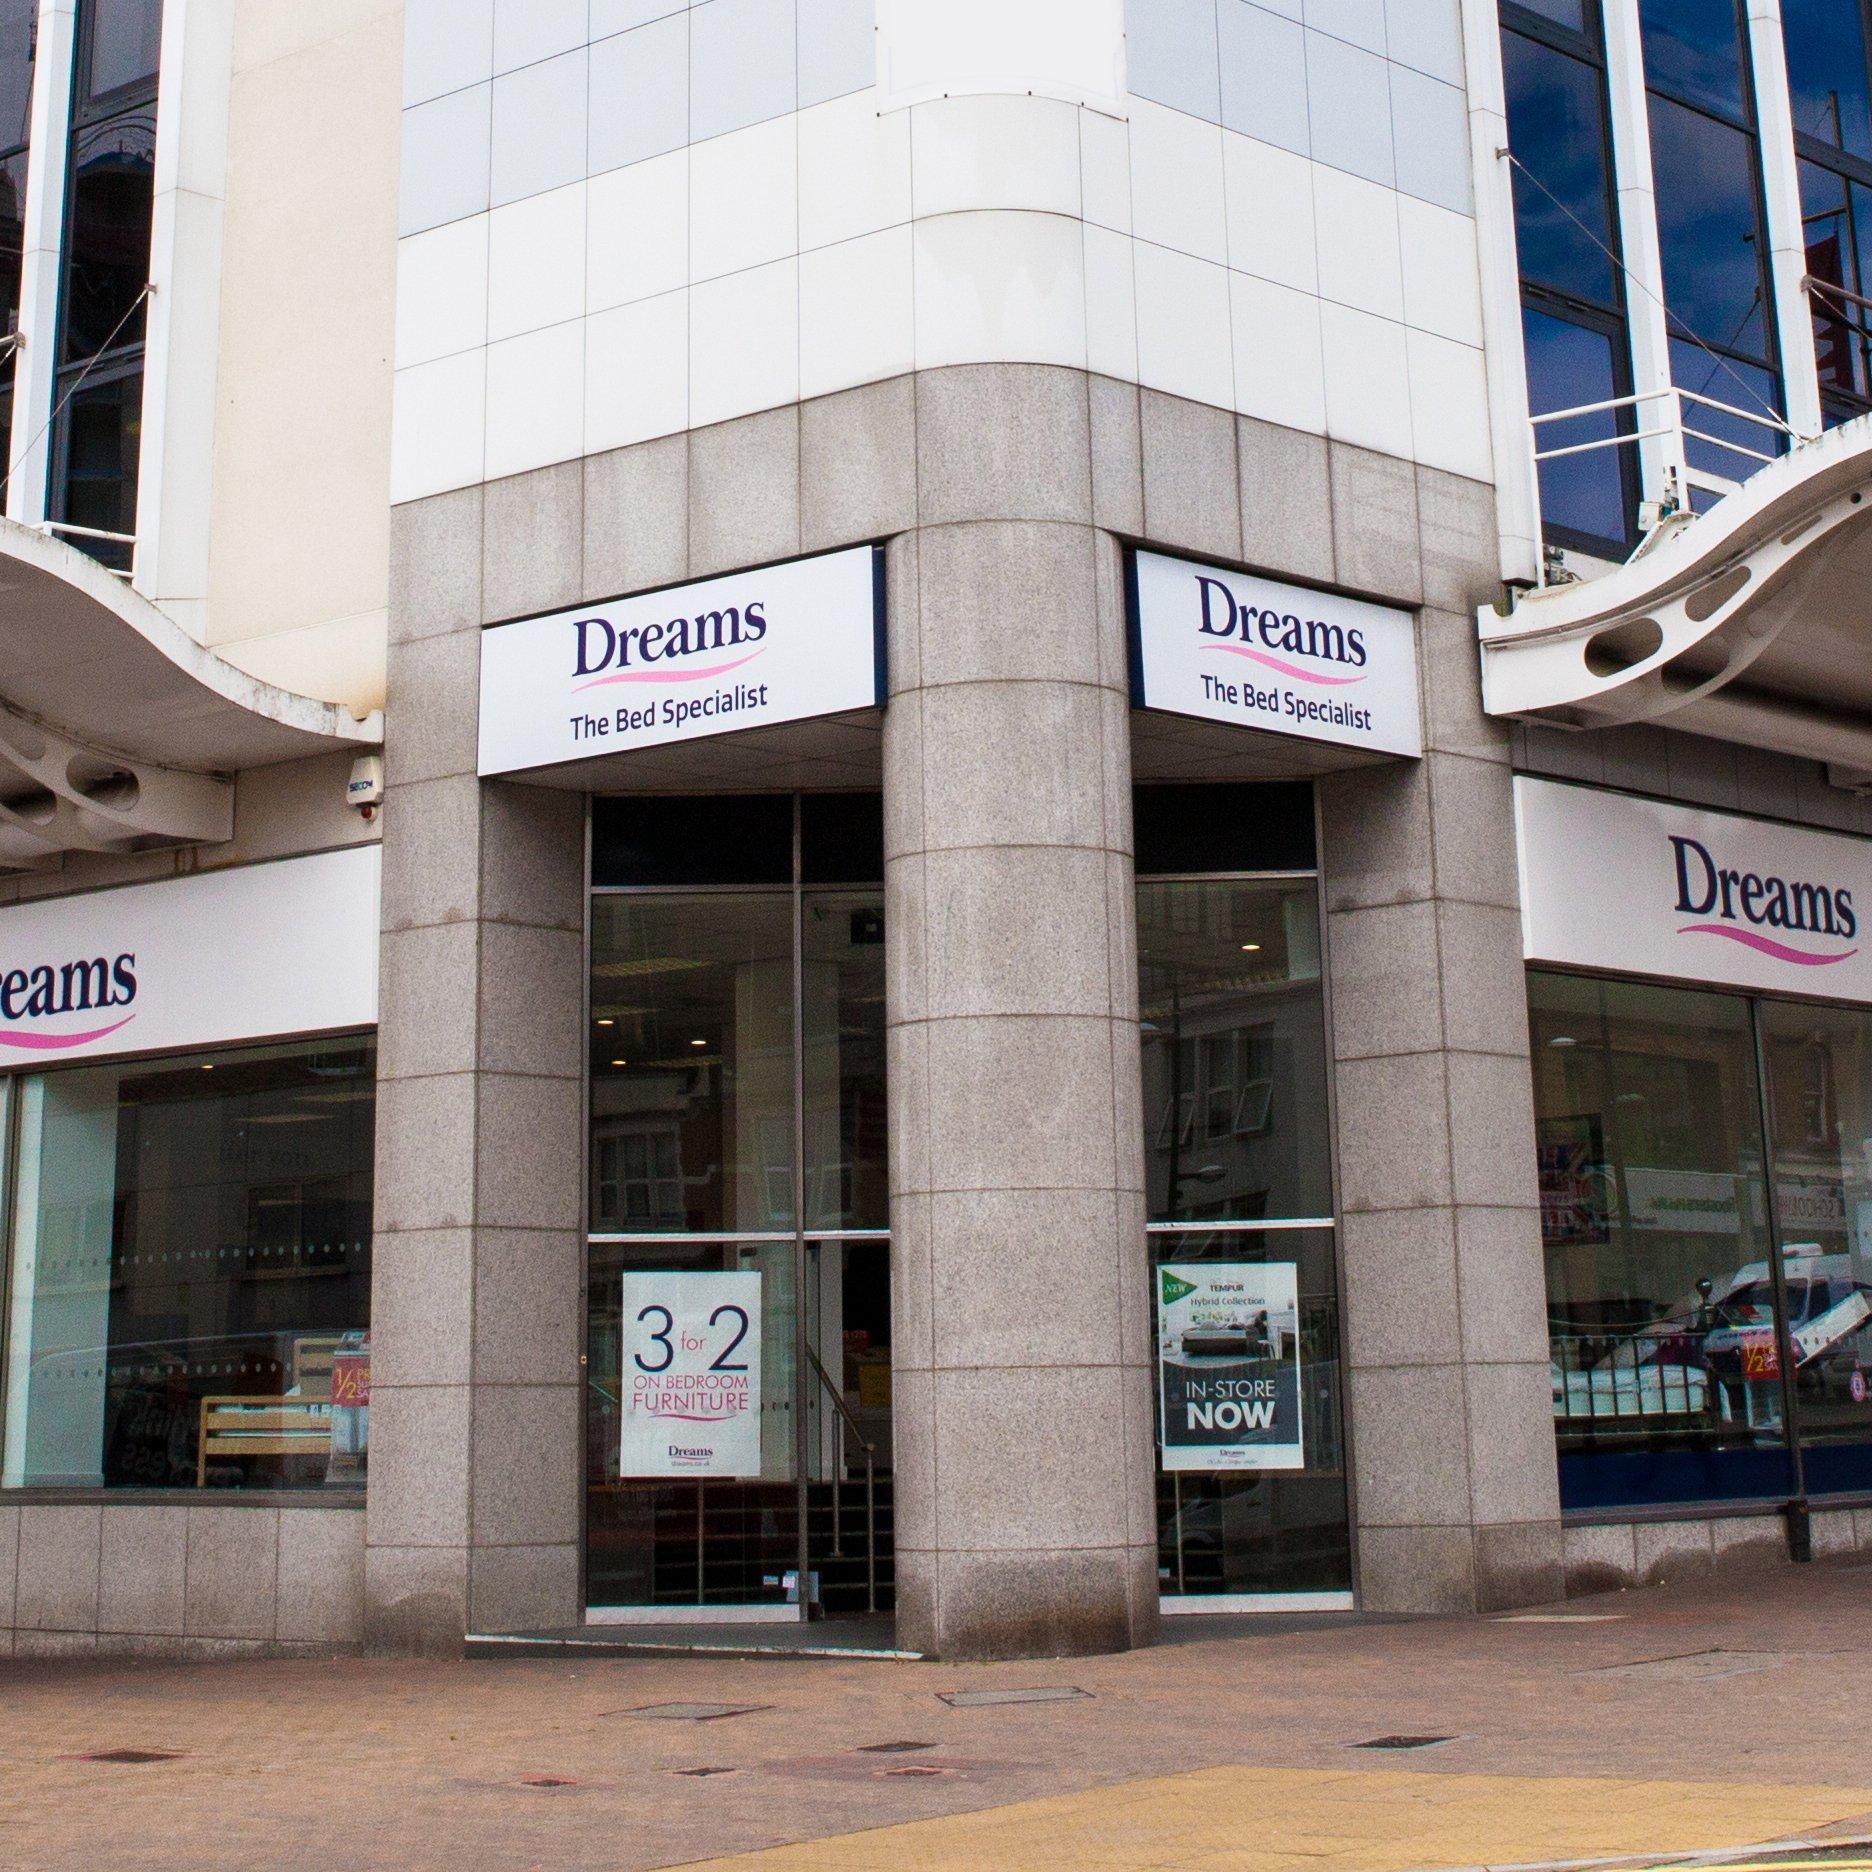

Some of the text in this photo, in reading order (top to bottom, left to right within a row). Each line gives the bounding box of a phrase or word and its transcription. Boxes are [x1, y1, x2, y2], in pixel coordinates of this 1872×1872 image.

[1195, 575, 1367, 667] Dreams
[572, 601, 767, 677] Dreams
[570, 683, 768, 740] The Bed Specialist
[1200, 674, 1372, 730] The Bed Specialist
[1668, 835, 1856, 940] Dreams
[1190, 1296, 1266, 1307] Hybrid Collection
[1210, 1283, 1244, 1293] TEMPUR
[634, 1304, 749, 1372] 3 for 2
[633, 1374, 749, 1390] ON BEDROOM
[1186, 1379, 1276, 1398] IN-STORE
[633, 1392, 749, 1411] FURNITURE
[1187, 1401, 1276, 1430] NOW
[668, 1445, 713, 1457] Dreams
